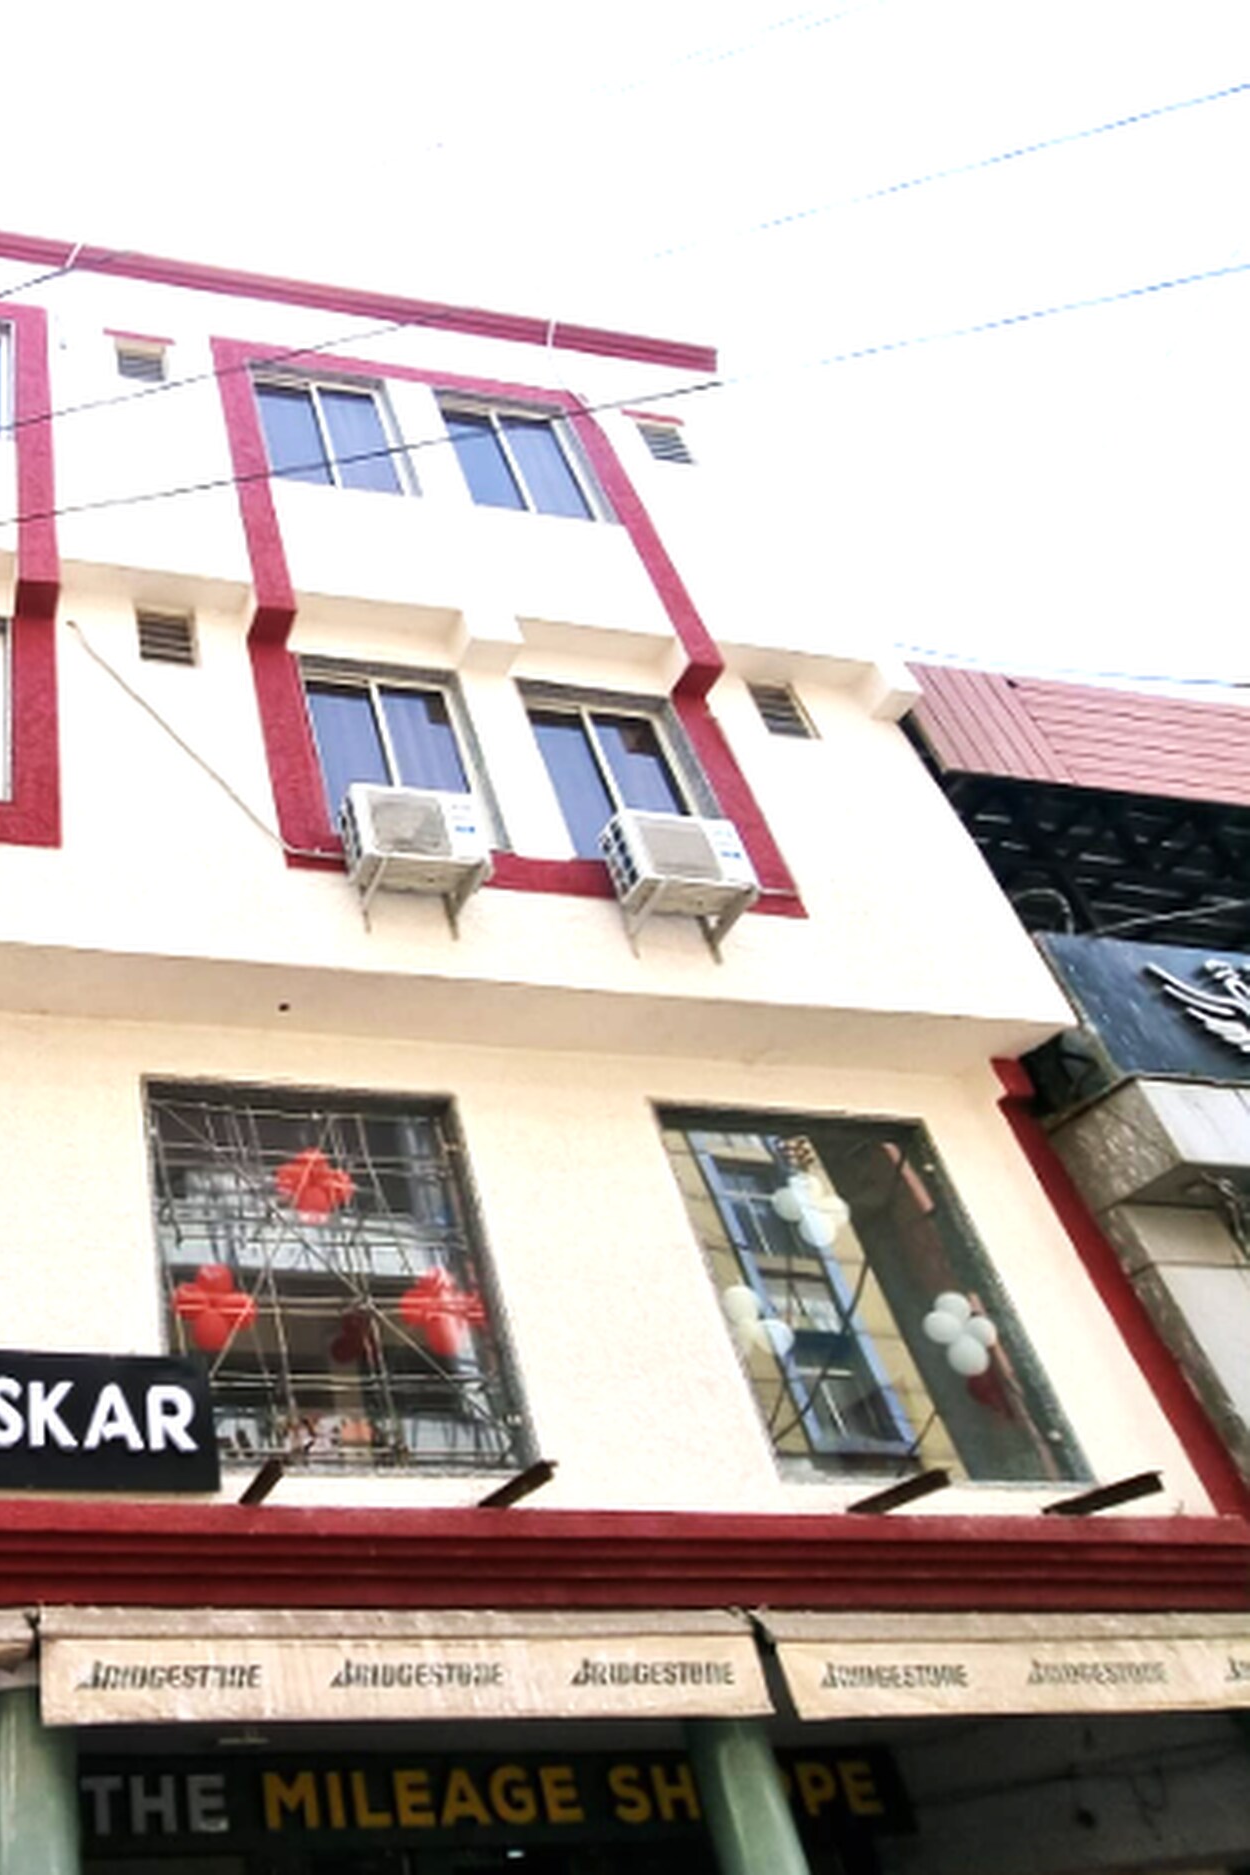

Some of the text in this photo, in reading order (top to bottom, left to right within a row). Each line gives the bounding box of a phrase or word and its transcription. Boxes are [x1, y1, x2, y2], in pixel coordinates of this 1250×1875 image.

[81, 1760, 885, 1836] THE MILEAGE SHPE
